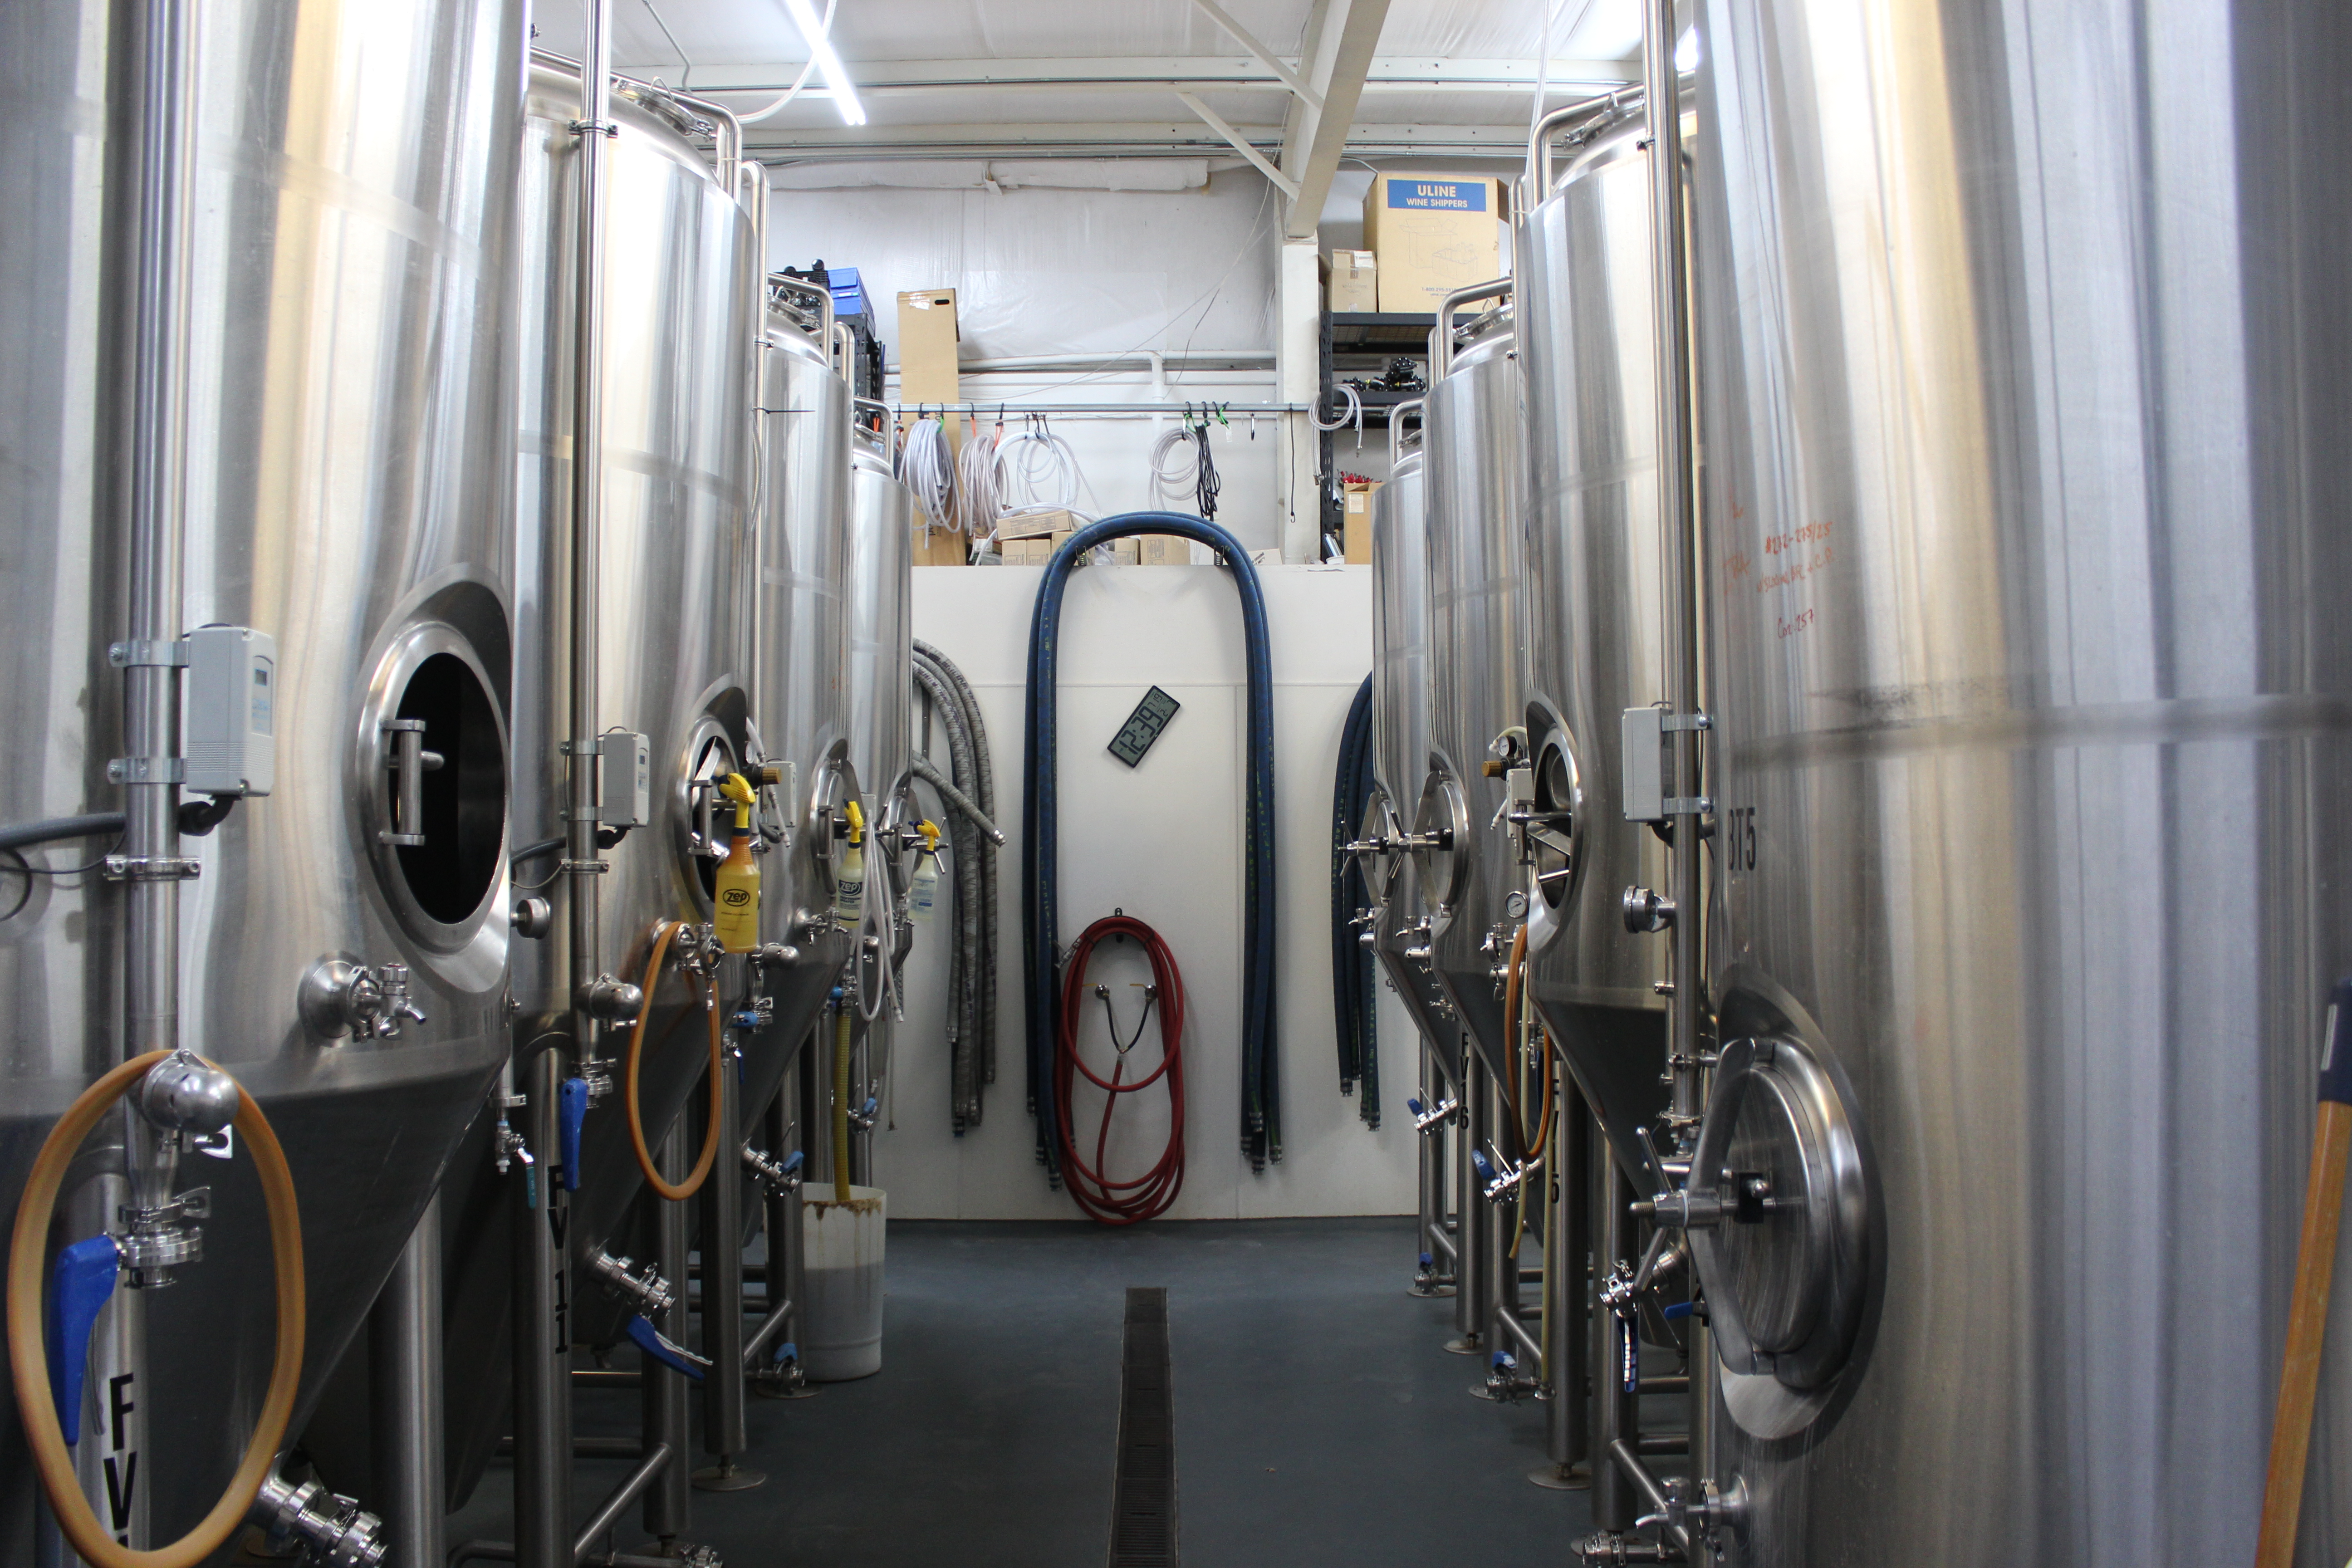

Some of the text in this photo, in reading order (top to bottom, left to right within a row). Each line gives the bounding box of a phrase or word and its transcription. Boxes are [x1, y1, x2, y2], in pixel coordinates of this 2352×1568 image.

[1406, 198, 1468, 208] WINE SHIPPERS
[1417, 185, 1456, 197] ULINE
[1119, 706, 1164, 755] 12:39
[1728, 807, 1756, 871] BT5
